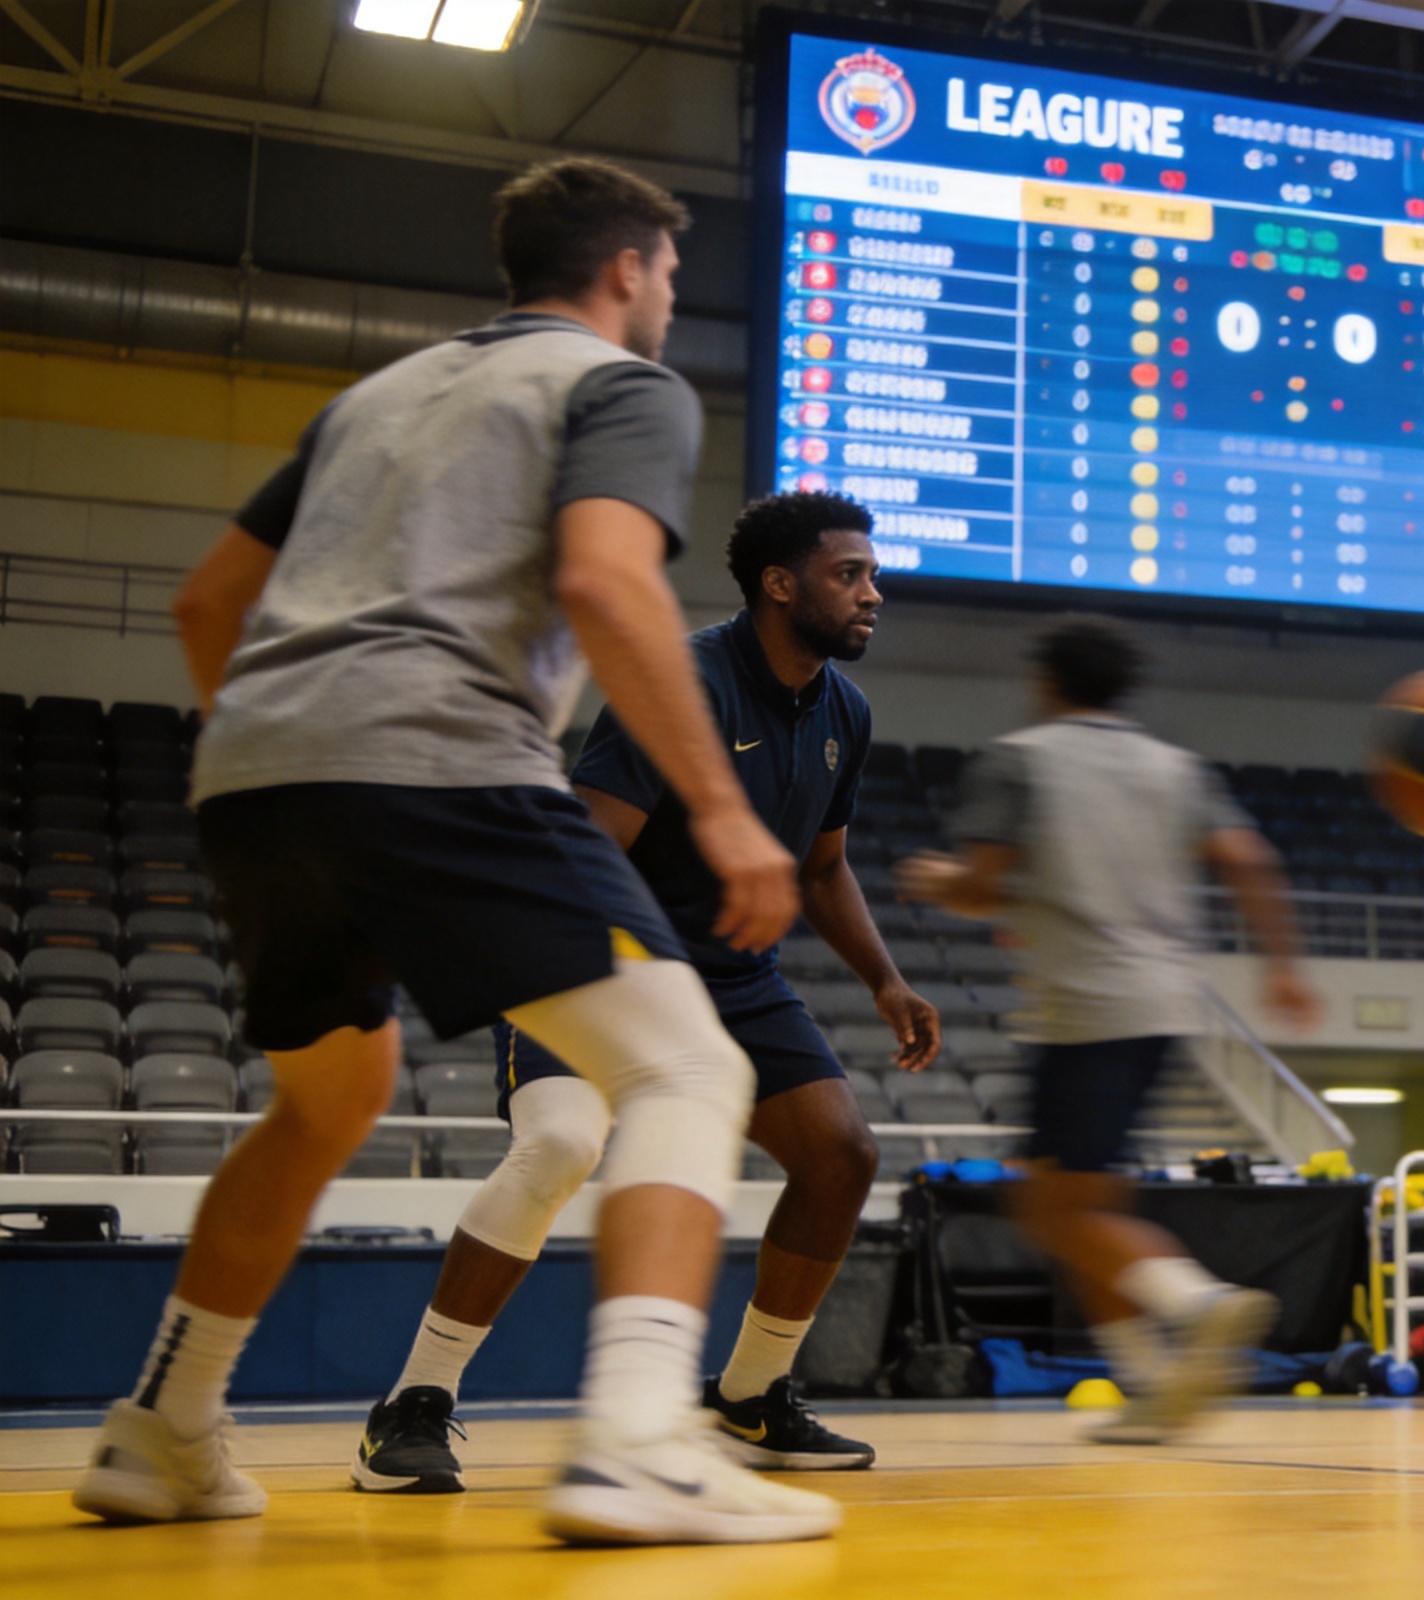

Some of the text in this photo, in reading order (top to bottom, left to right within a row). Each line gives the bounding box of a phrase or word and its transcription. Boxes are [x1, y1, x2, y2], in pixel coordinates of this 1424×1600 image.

[946, 77, 1185, 159] LEAGURE
[1217, 301, 1261, 353] 0
[1333, 313, 1377, 364] 0
